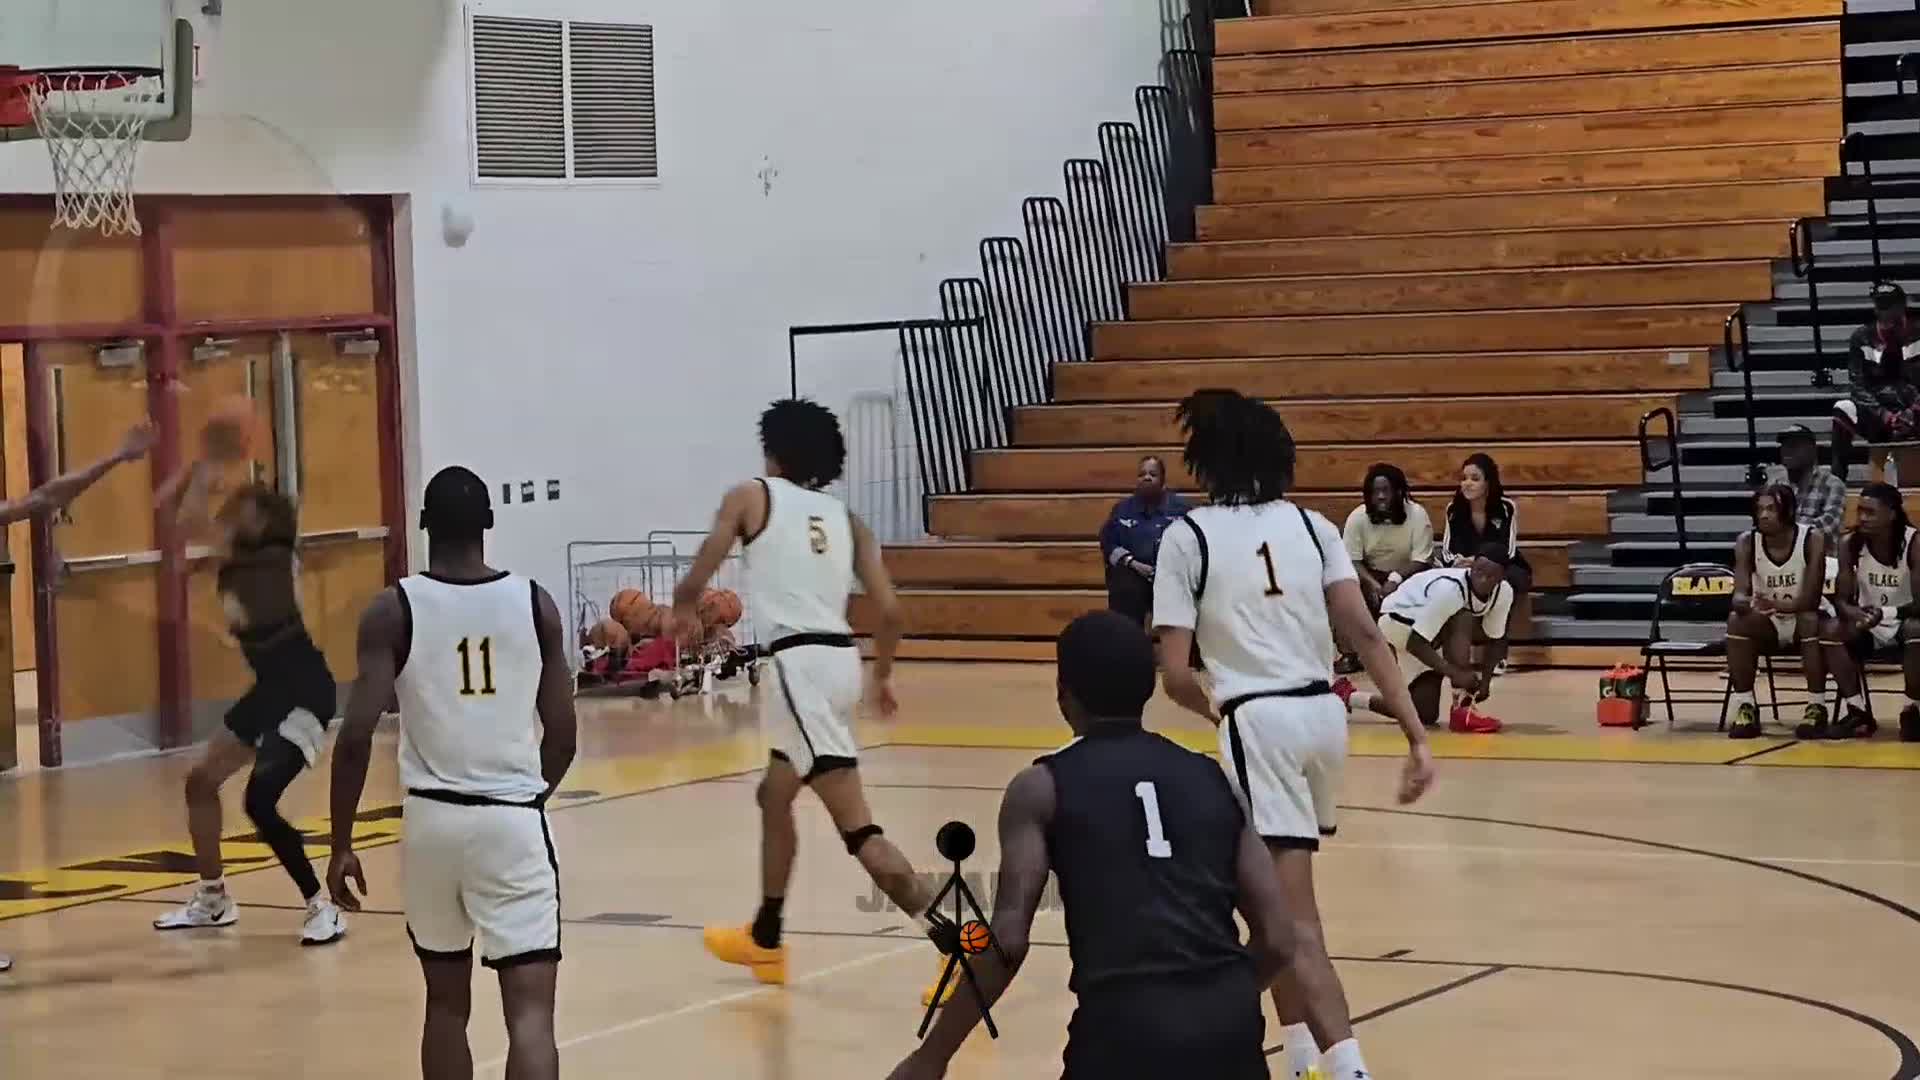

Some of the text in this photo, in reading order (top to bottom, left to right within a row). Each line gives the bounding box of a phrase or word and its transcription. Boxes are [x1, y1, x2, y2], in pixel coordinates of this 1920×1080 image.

[1256, 541, 1284, 597] 1
[1767, 573, 1797, 588] BLAKE
[1868, 572, 1899, 587] BLAKE
[457, 636, 497, 696] 11
[1134, 781, 1172, 858] 1
